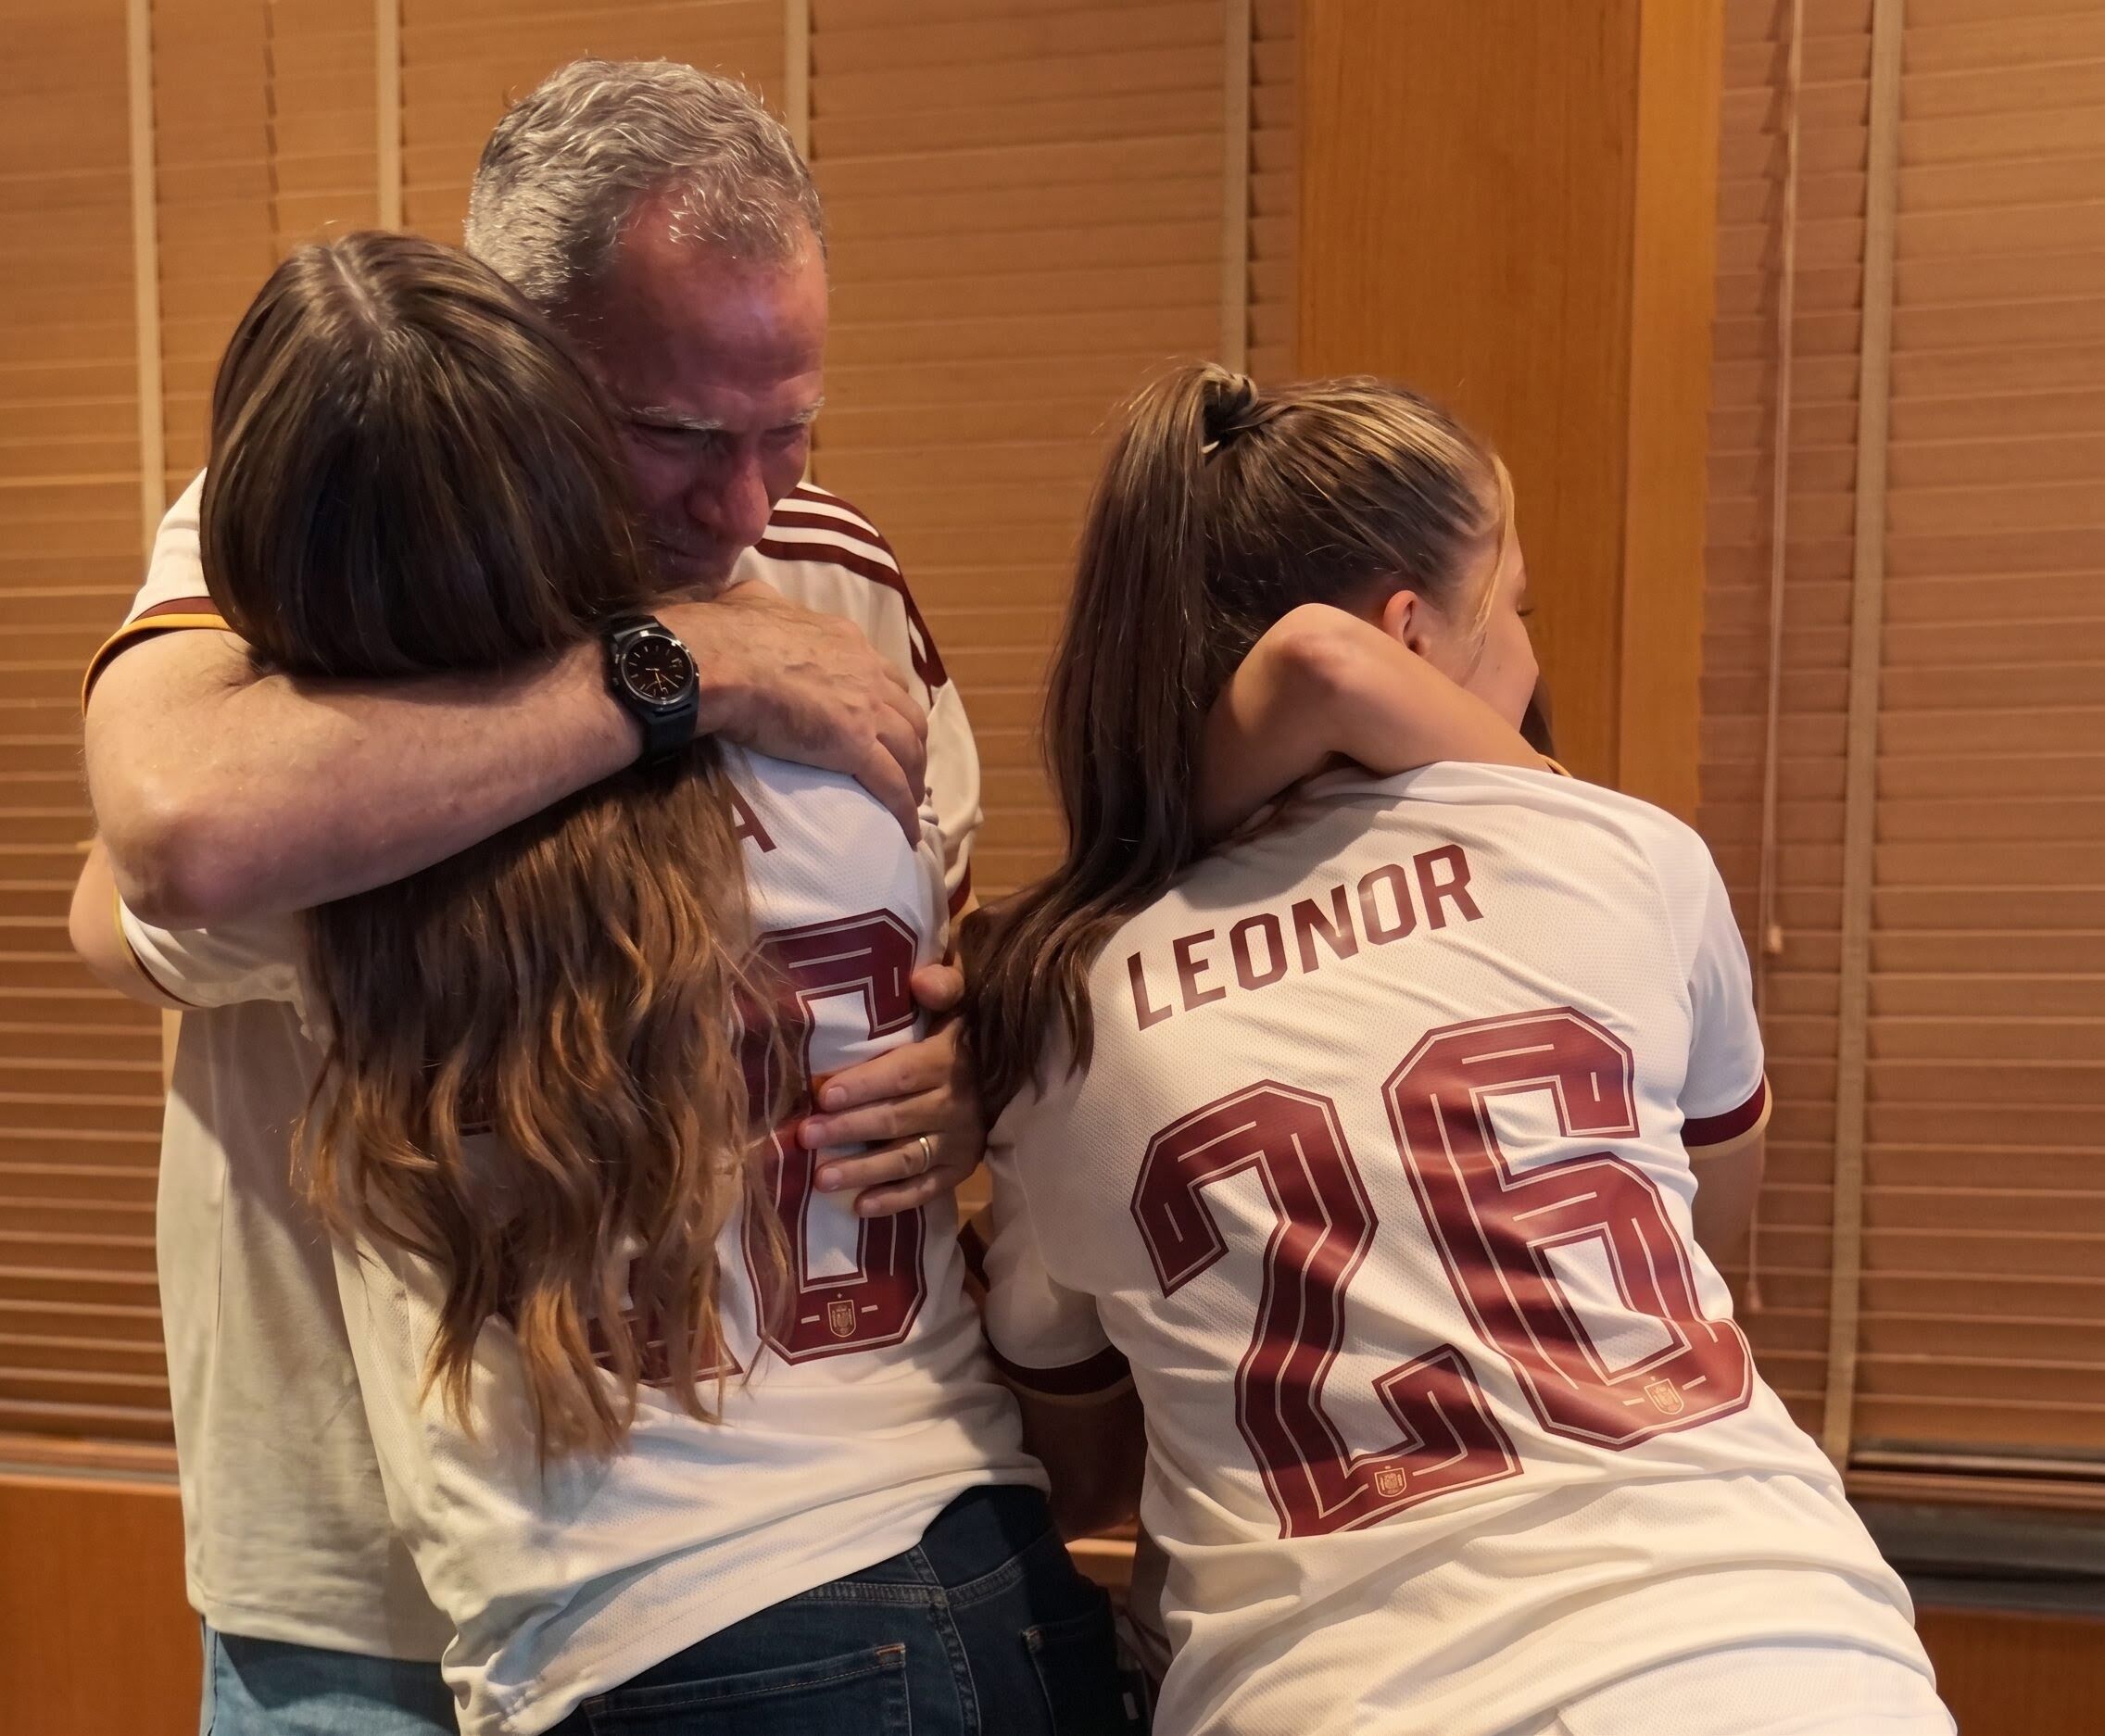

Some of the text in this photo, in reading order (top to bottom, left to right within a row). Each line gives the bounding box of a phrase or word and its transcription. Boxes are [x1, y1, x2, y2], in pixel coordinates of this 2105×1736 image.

[593, 908, 927, 1388] 6
[1127, 844, 1484, 1031] LEONOR
[1129, 1006, 1753, 1540] 26
